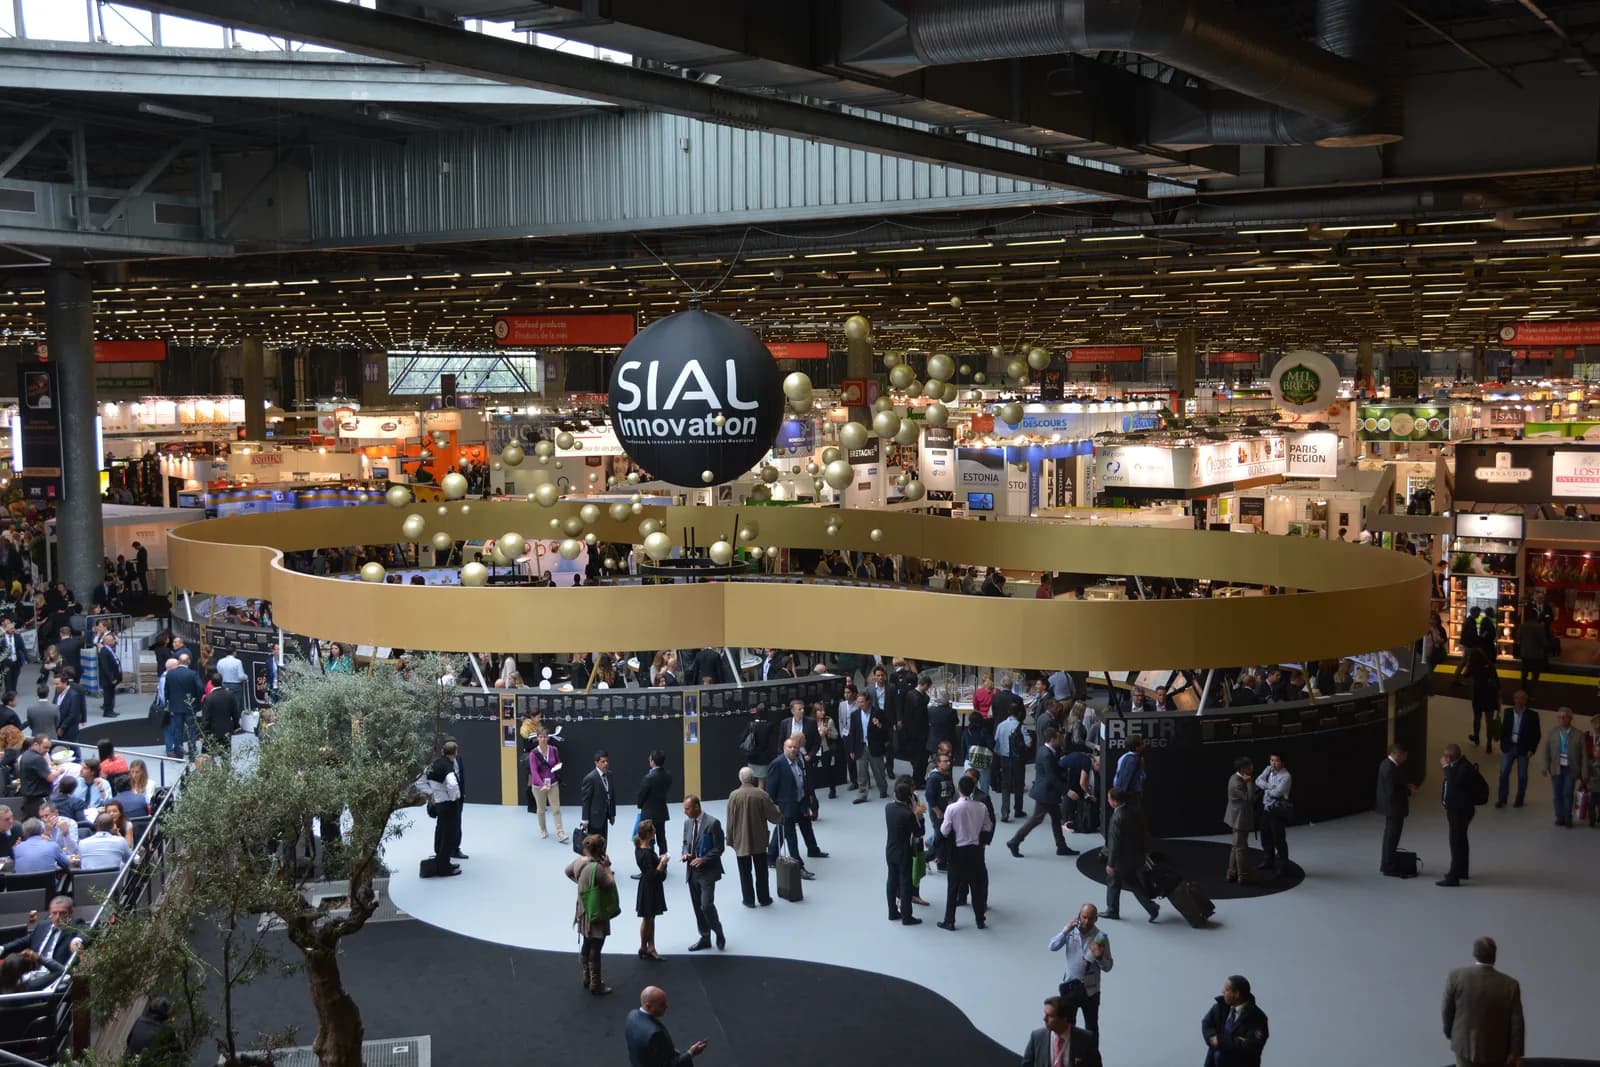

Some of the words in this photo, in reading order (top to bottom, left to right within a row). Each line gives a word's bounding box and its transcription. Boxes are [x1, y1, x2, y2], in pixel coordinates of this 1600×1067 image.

[617, 359, 759, 412] SIAL
[618, 412, 757, 437] Innovation
[1290, 444, 1318, 453] PARIS
[1290, 453, 1326, 463] REGION
[963, 473, 999, 482] ESTONIA
